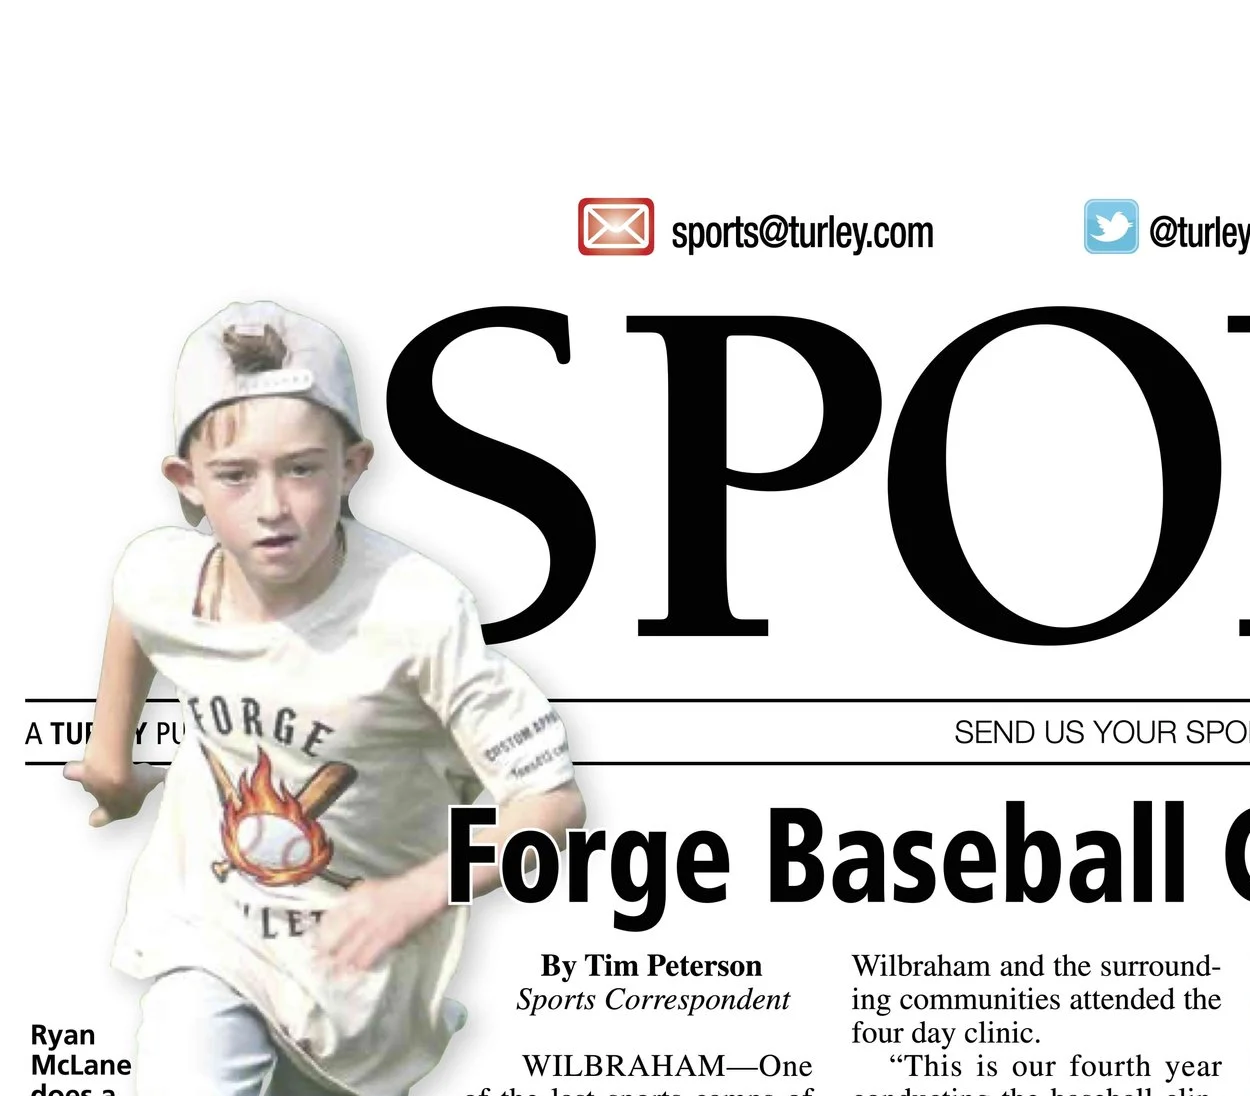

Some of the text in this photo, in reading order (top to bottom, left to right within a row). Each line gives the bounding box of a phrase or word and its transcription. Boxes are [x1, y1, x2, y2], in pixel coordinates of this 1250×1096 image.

[672, 214, 934, 256] sports@turley.com
[24, 721, 43, 745] A
[50, 721, 148, 745] TUY
[187, 694, 336, 758] FORGE
[955, 719, 1035, 745] SEND
[1045, 719, 1085, 745] US
[1092, 719, 1177, 745] YOUR
[451, 807, 730, 932] Forge
[770, 800, 1184, 904] Baseball
[540, 953, 763, 983] By Tim Peterson
[851, 953, 1221, 977] Wilbraham and the surround-
[516, 987, 792, 1017] Sports Correspondent
[31, 1024, 95, 1052] Ryan
[851, 1020, 1041, 1050] four day clinic.
[32, 1054, 132, 1076] McLane
